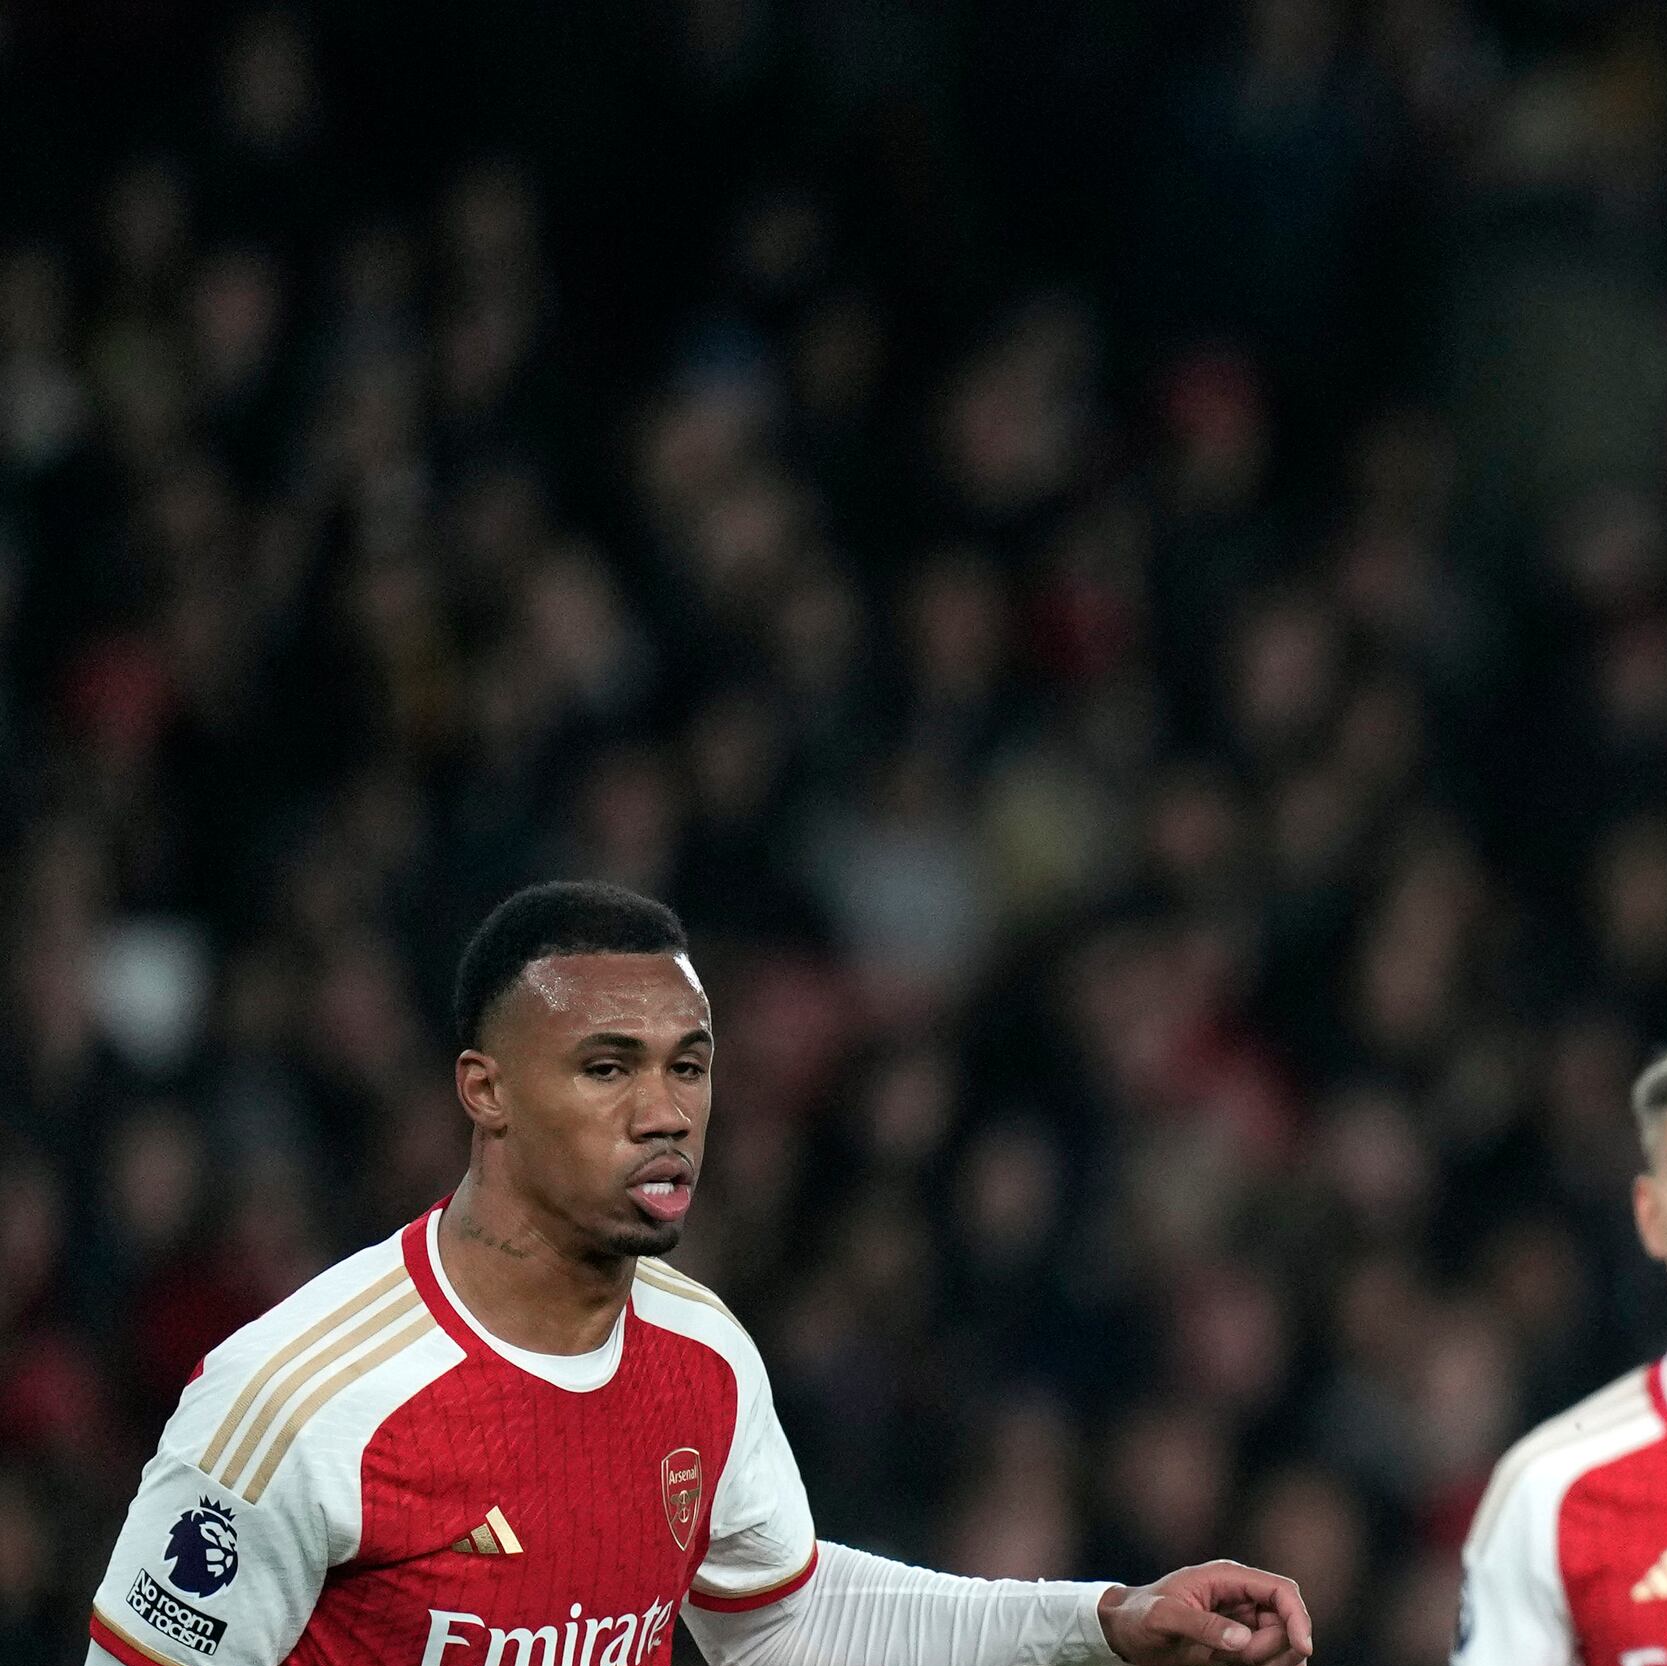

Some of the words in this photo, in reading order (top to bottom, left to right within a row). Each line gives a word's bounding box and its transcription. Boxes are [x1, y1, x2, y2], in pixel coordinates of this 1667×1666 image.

[669, 1464, 697, 1486] Arsenal
[126, 1585, 151, 1615] for
[148, 1609, 217, 1654] racism
[135, 1570, 158, 1601] No
[157, 1595, 214, 1636] room
